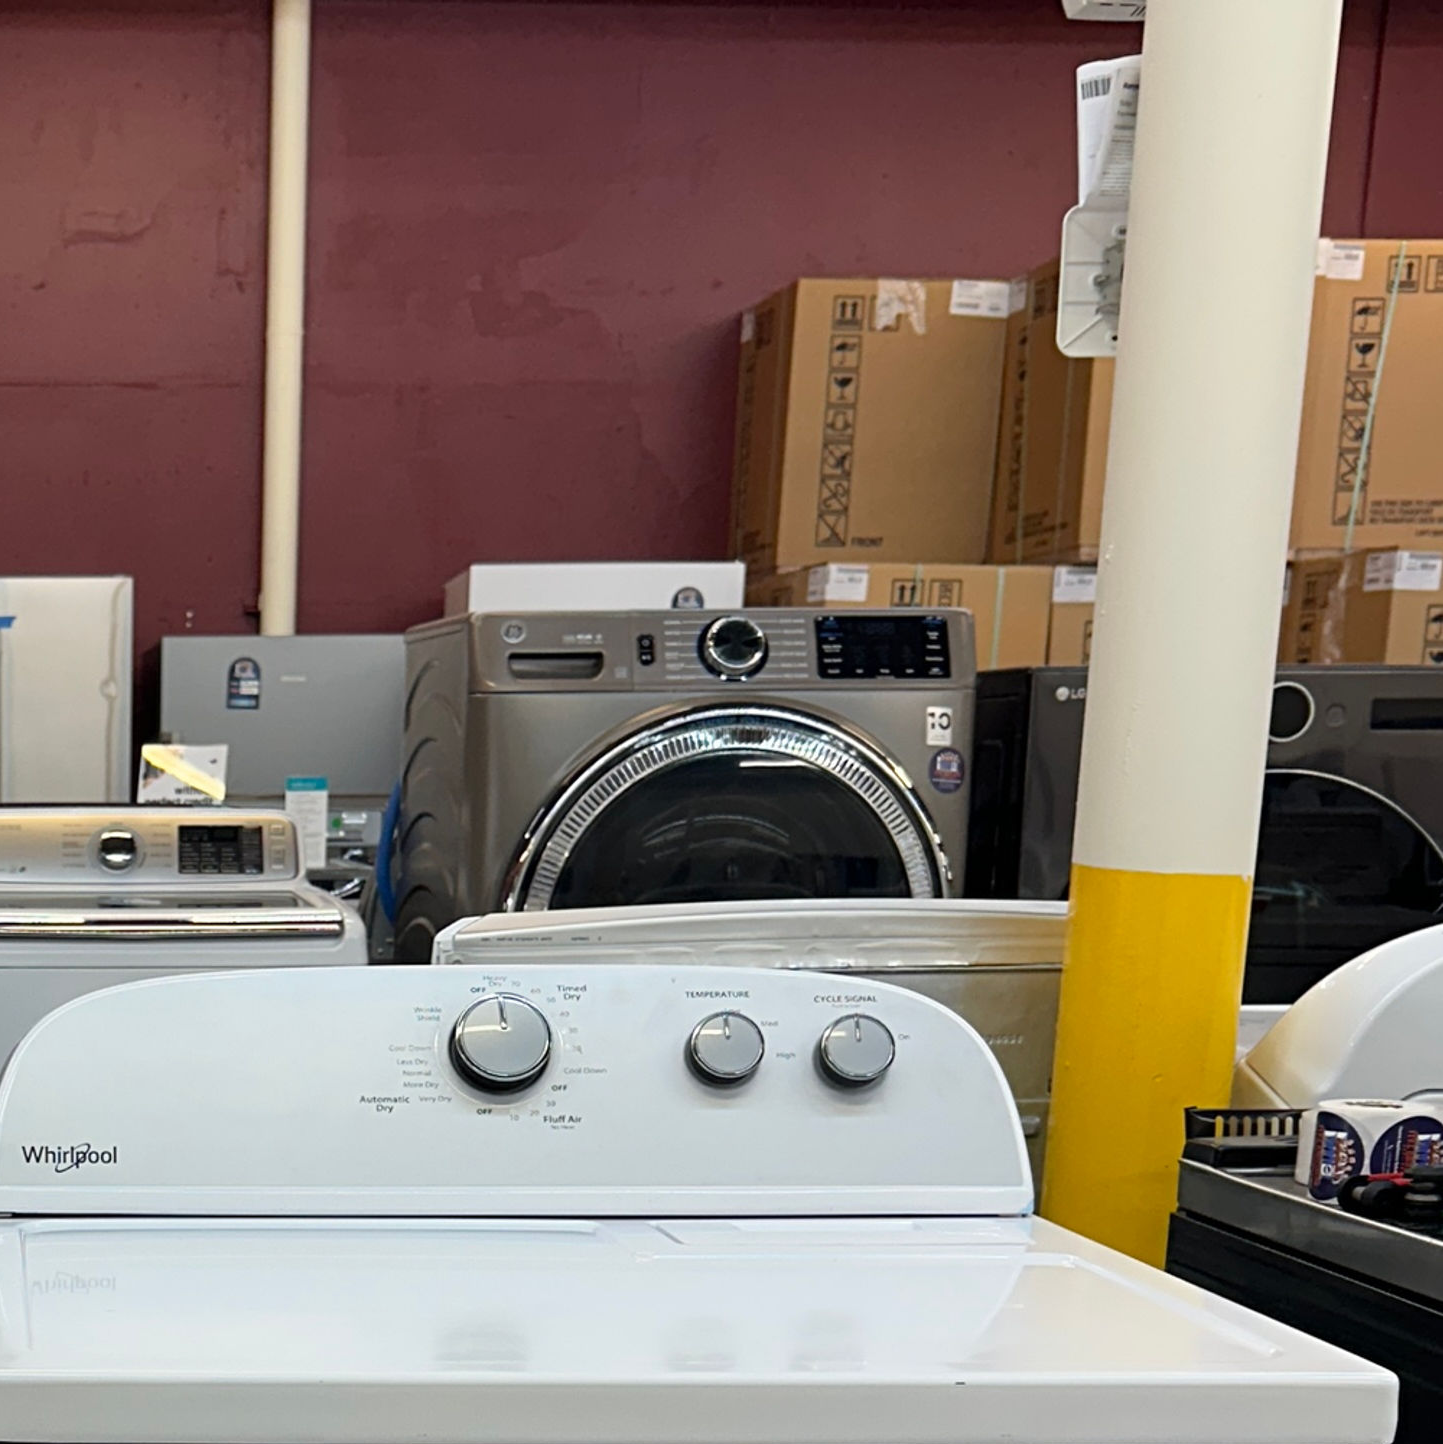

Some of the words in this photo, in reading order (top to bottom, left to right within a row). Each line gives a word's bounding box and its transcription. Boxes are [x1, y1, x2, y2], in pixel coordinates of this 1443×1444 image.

[556, 984, 587, 993] Timed
[563, 993, 581, 1002] Dry
[684, 990, 751, 999] TEMPERATURE
[813, 995, 842, 1003] CYCLE
[844, 995, 877, 1003] SIGNAL
[551, 1084, 567, 1092] OFF
[359, 1095, 410, 1104] Automatic
[376, 1104, 394, 1114] Dry
[543, 1115, 566, 1123] Fluff
[568, 1115, 582, 1123] Air
[21, 1145, 118, 1169] Whirlpool
